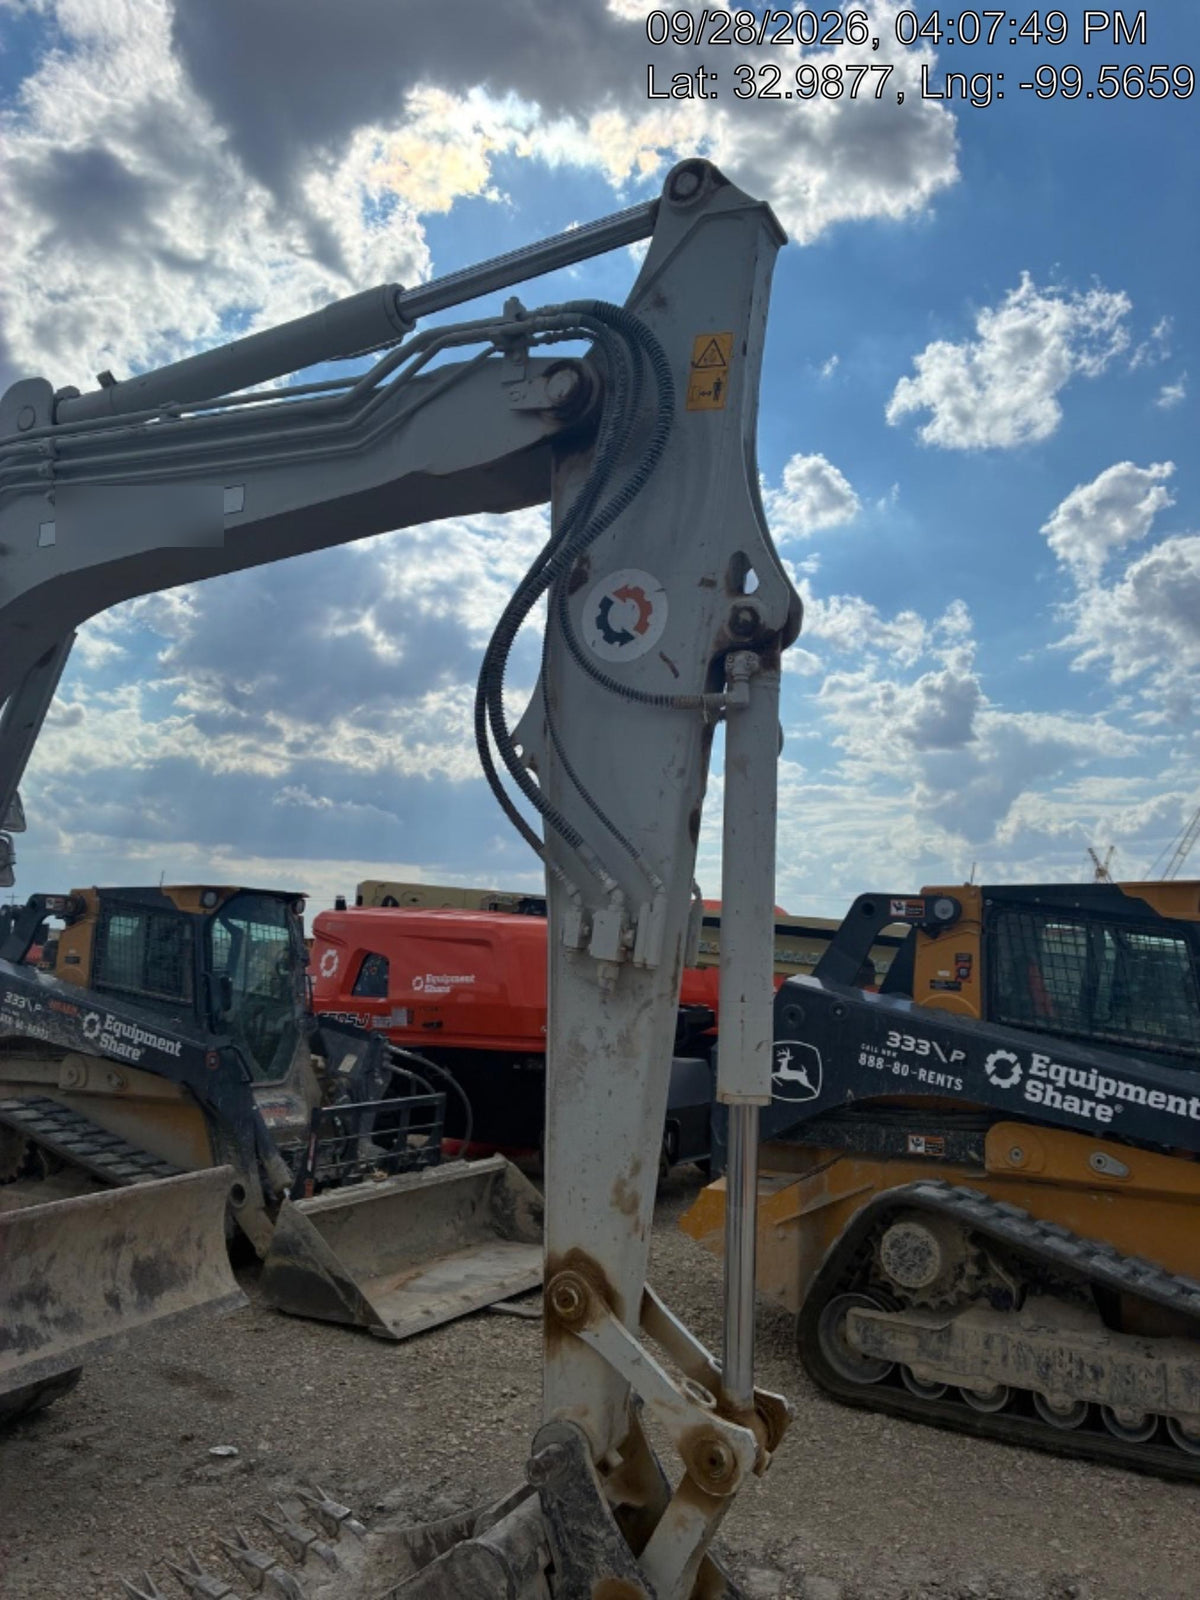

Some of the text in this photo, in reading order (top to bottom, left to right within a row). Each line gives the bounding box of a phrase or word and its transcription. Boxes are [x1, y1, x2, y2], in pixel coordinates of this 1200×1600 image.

[104, 1013, 182, 1057] Equipment
[858, 1052, 964, 1091] 888-80-RENTS
[1029, 1053, 1200, 1121] Equipment
